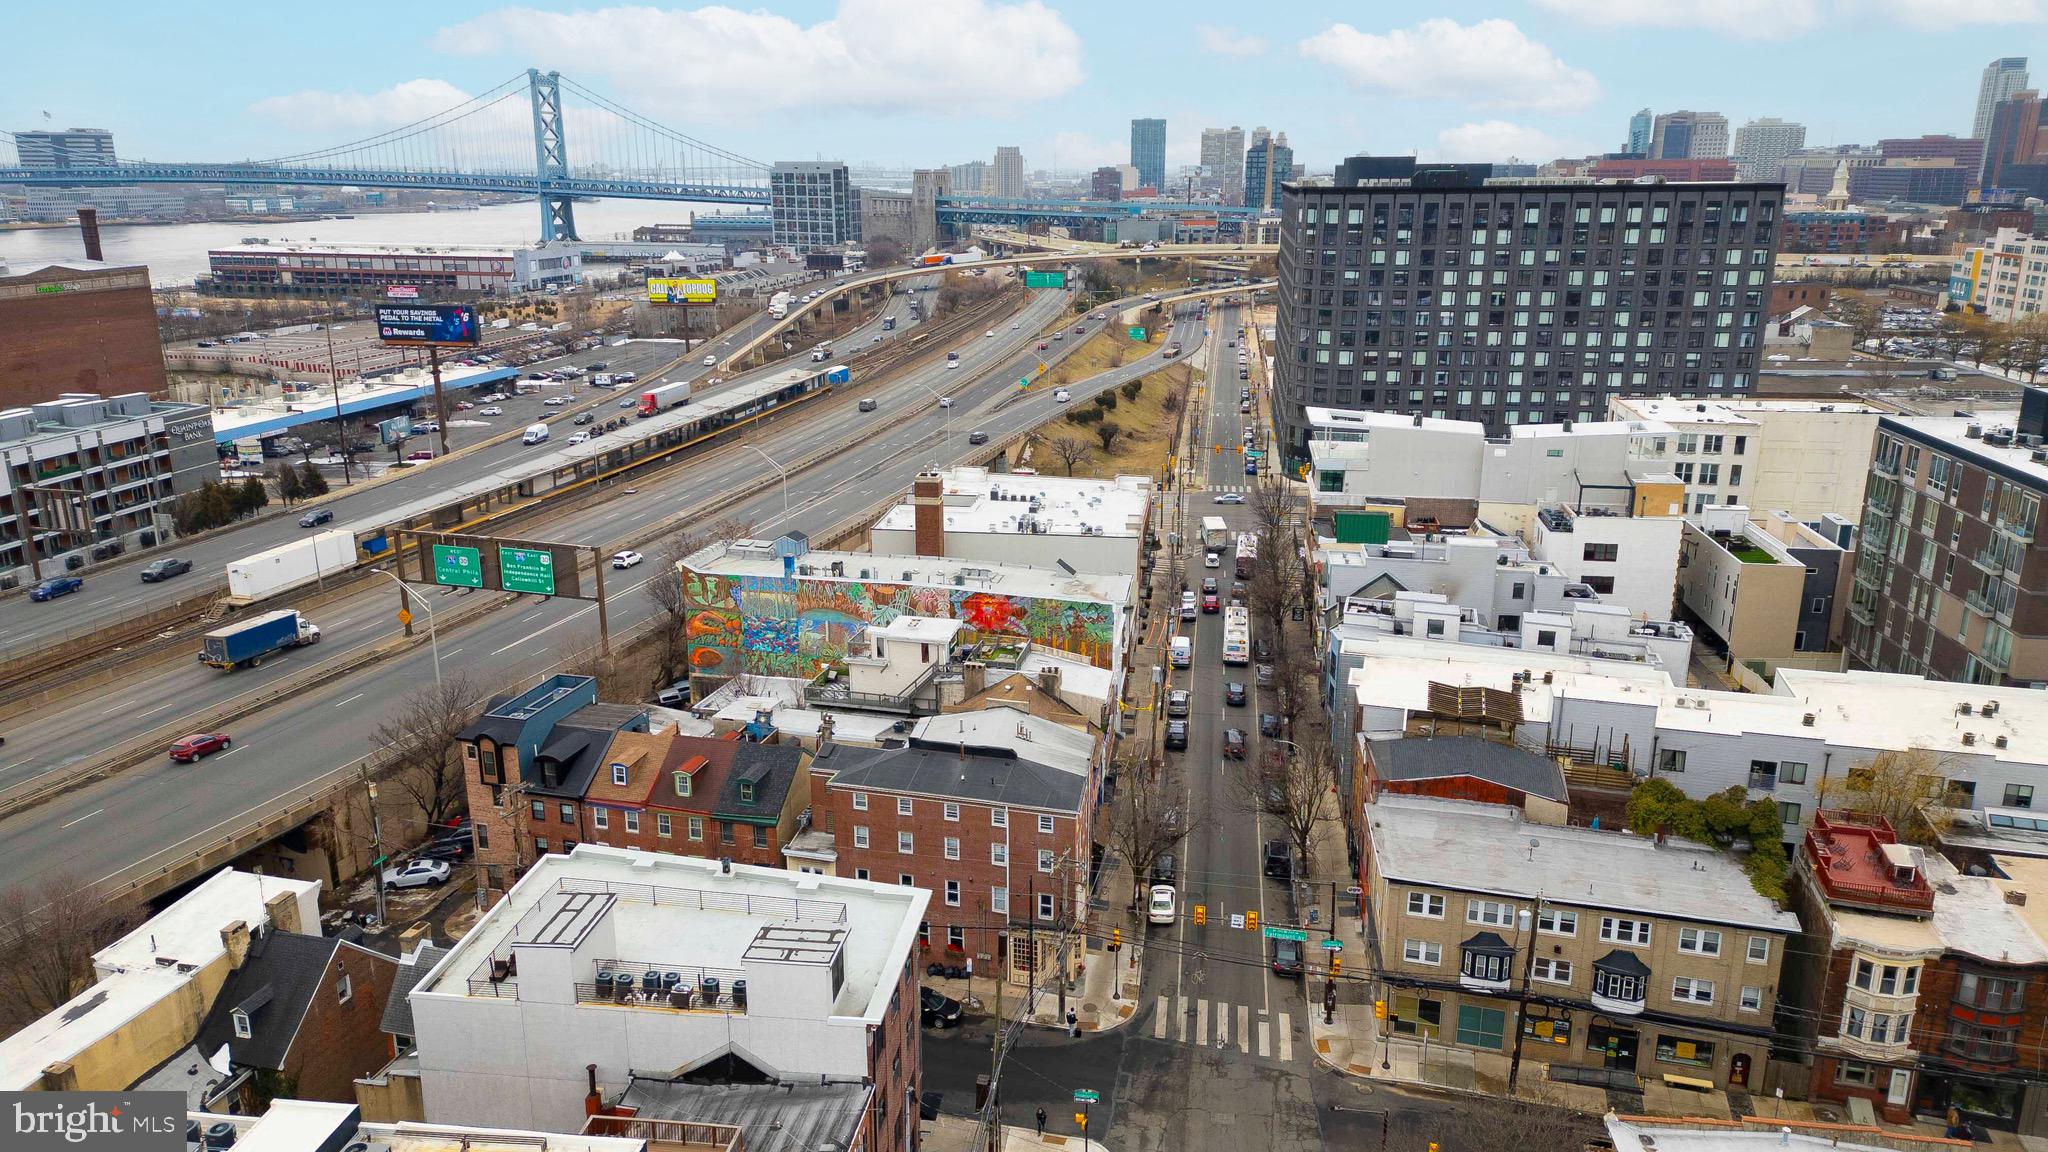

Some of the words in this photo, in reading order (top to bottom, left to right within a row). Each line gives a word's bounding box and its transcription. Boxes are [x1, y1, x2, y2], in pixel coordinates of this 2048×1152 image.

[650, 283, 668, 294] CALL
[682, 283, 713, 294] TOPDOG
[393, 328, 425, 336] Rewards
[171, 422, 198, 434] QUAINT
[184, 431, 204, 441] BANK
[437, 566, 461, 574] Central
[503, 569, 539, 577] Independence
